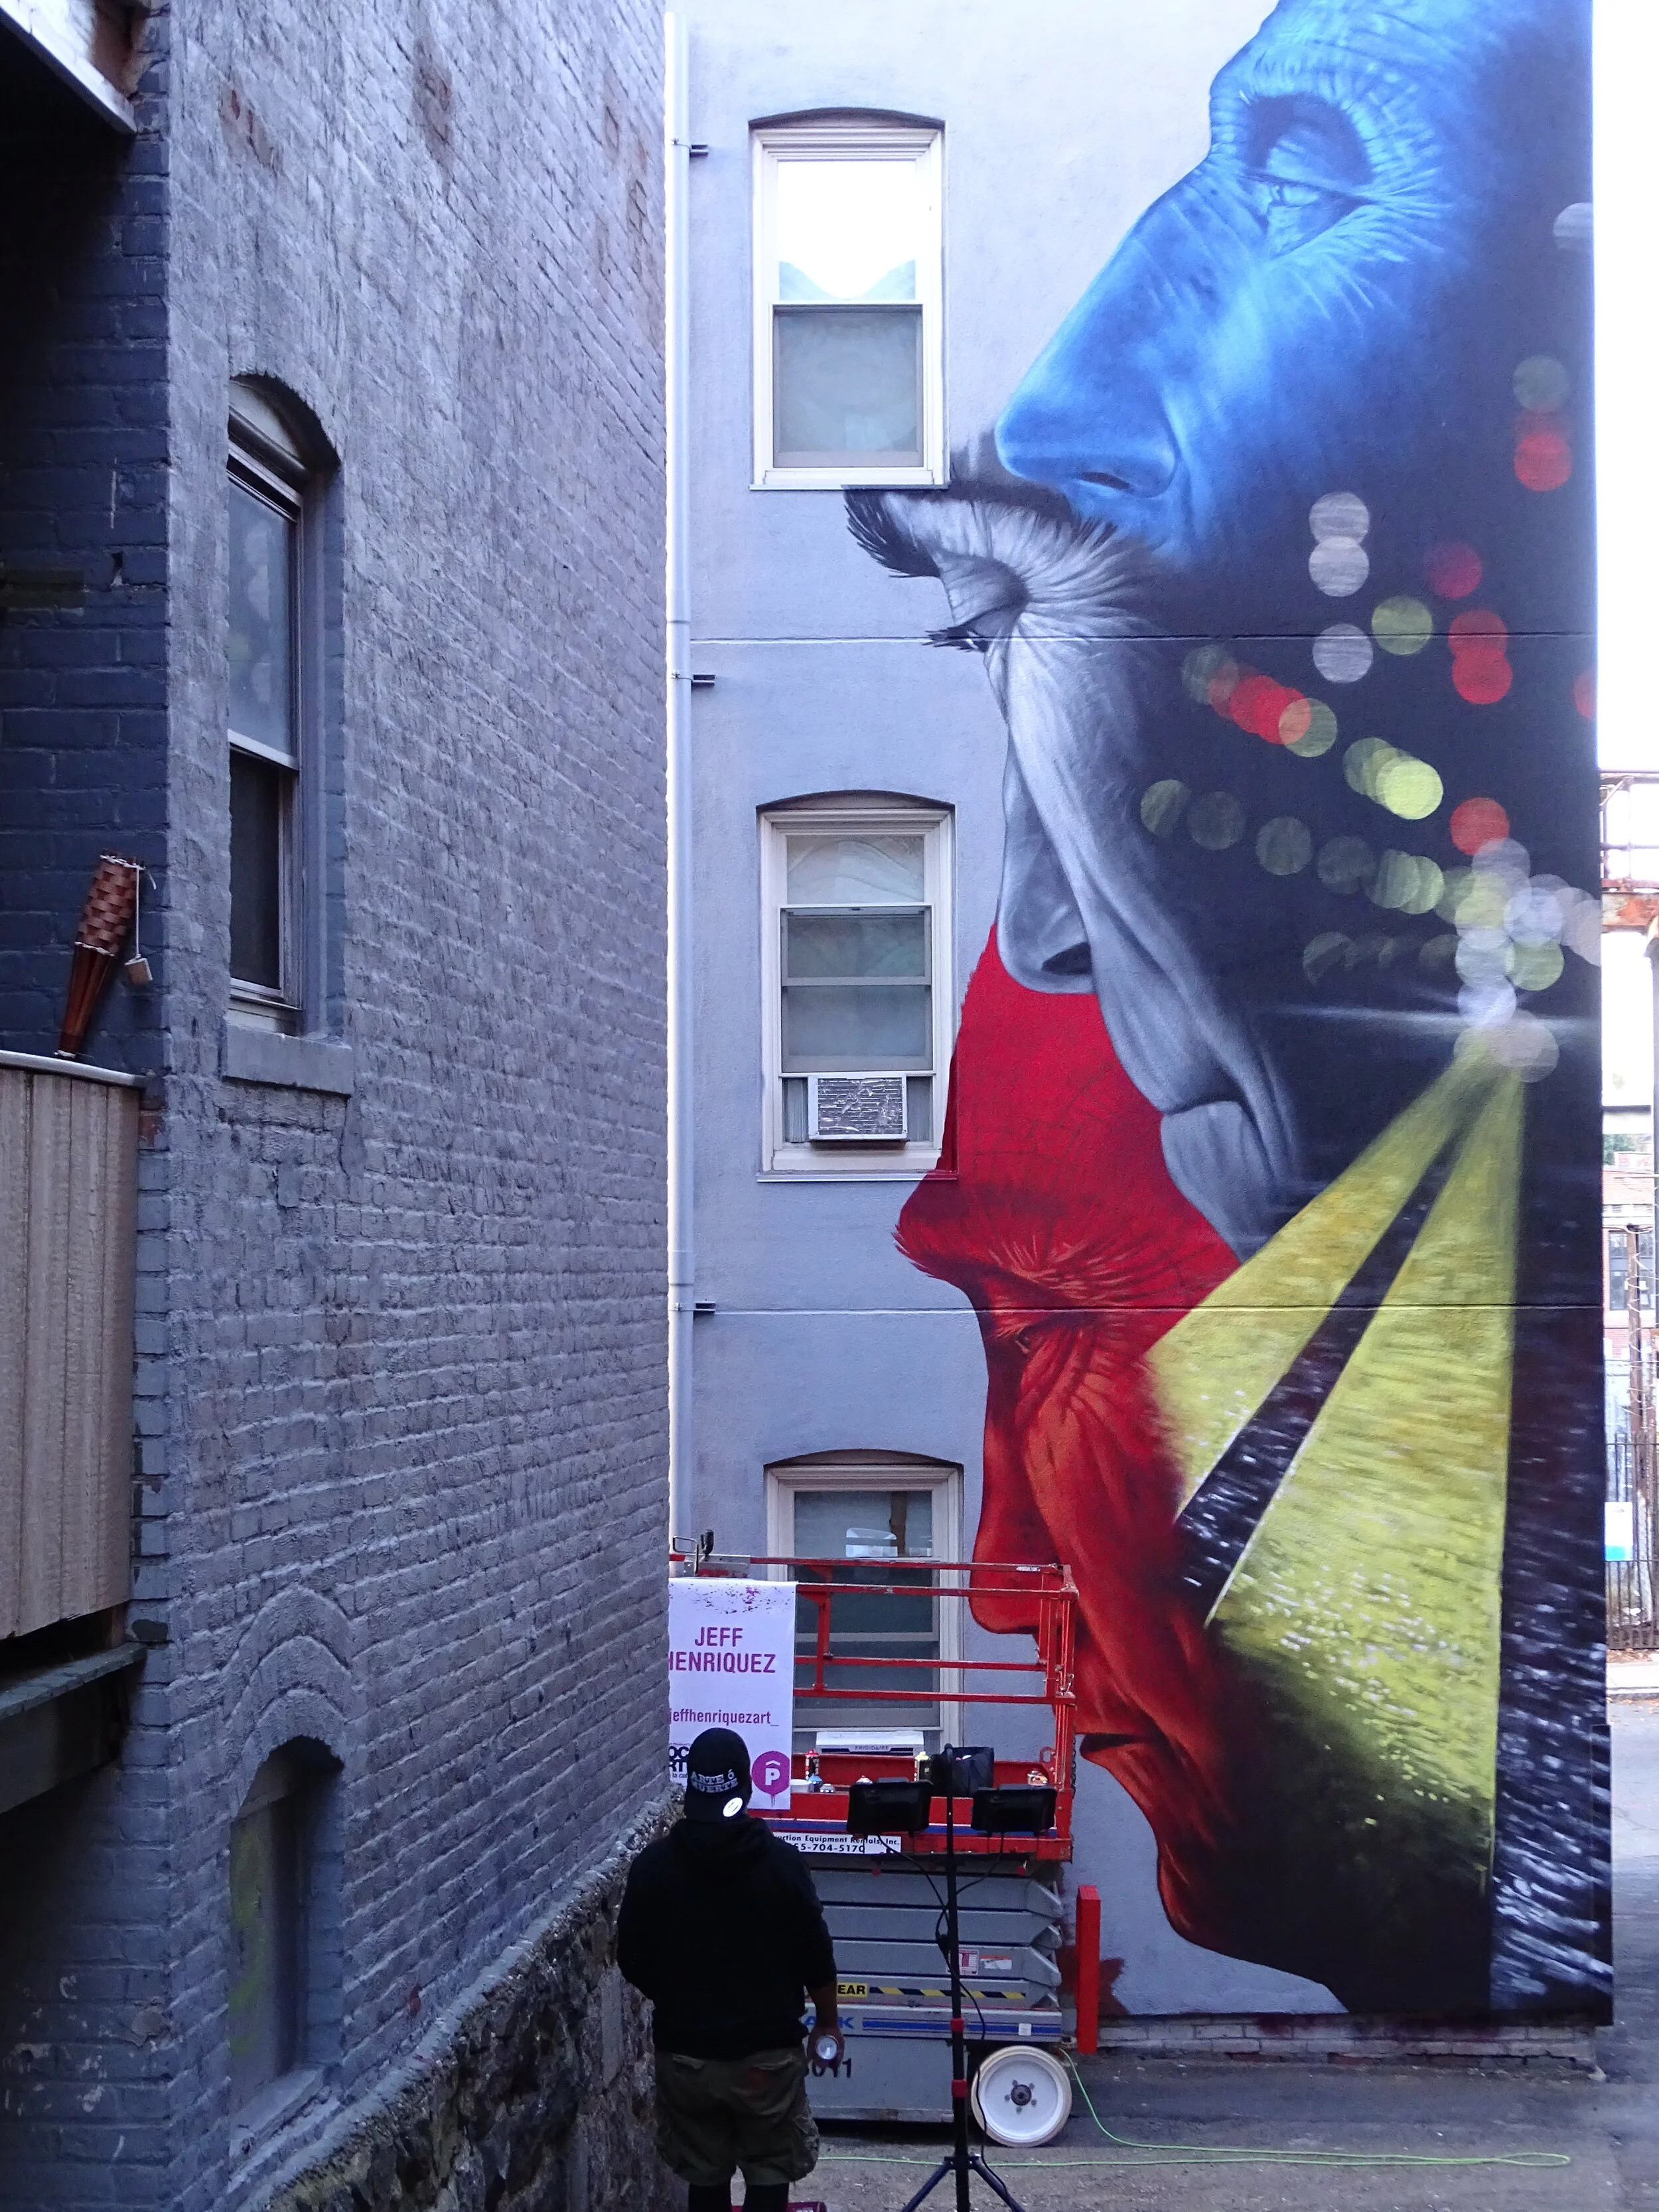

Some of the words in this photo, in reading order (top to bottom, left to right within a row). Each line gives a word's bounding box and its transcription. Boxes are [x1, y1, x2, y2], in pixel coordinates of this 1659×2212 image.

[695, 1627, 743, 1647] JEFF
[805, 1835, 847, 1844] Equipment
[837, 1985, 865, 1995] EAR
